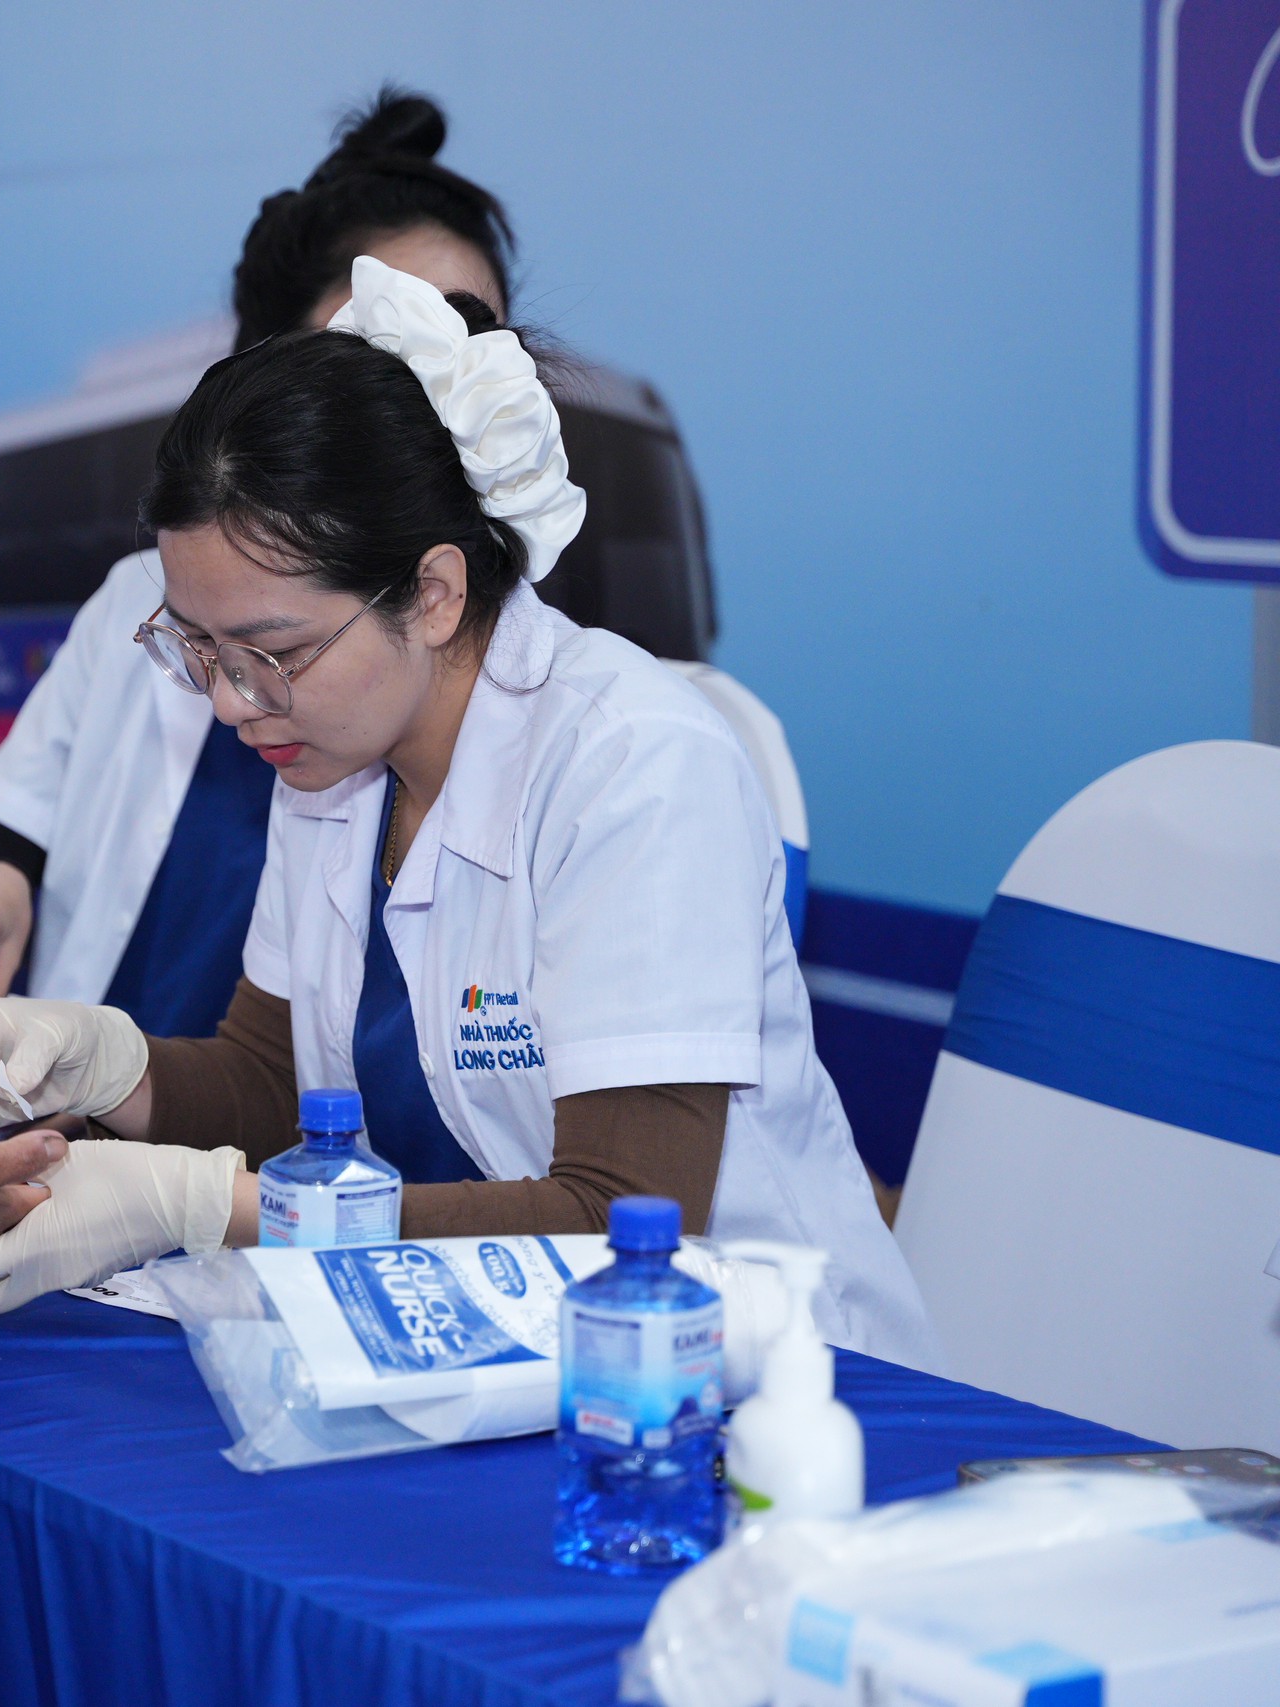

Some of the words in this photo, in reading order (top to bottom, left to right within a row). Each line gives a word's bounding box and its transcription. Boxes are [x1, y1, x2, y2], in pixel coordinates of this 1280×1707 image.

[484, 992, 495, 1006] FPT
[495, 991, 519, 1006] Retail
[460, 1020, 484, 1042] NHÀ
[484, 1016, 533, 1042] THUỐC
[454, 1049, 496, 1071] LONG
[481, 1246, 506, 1277] 100
[366, 1250, 448, 1357] NURSE
